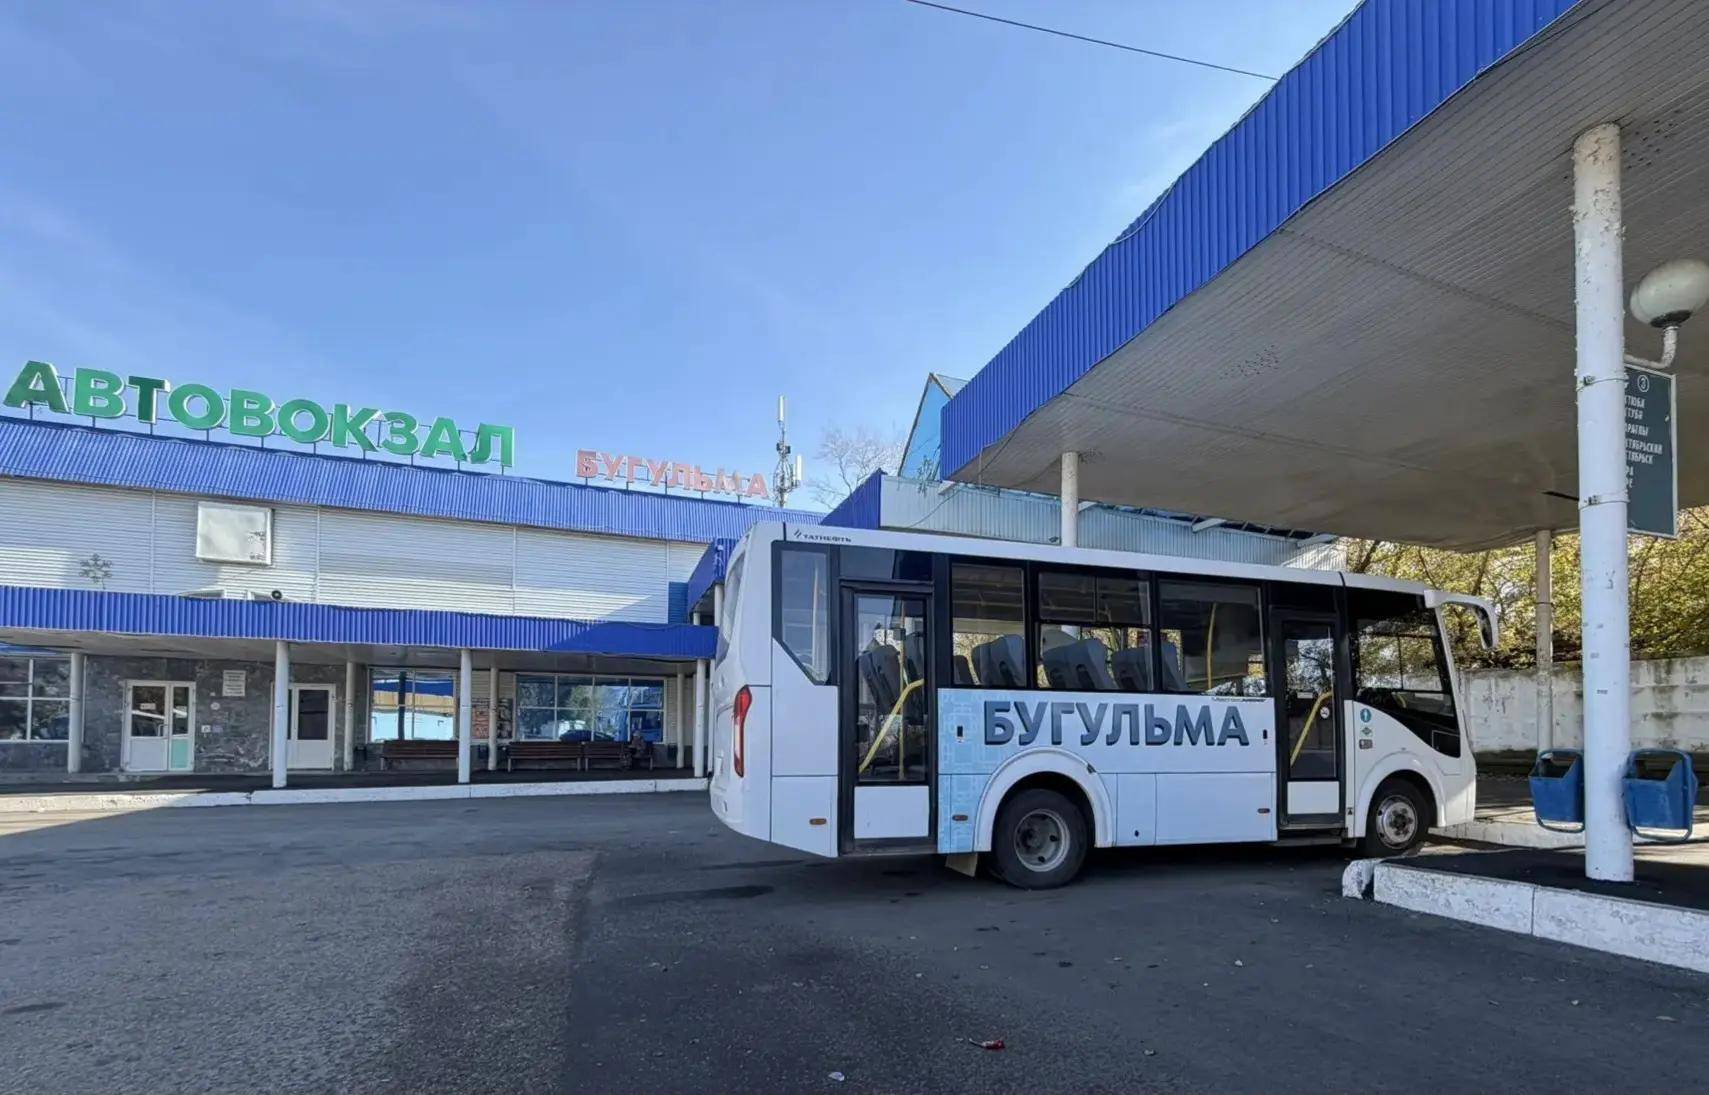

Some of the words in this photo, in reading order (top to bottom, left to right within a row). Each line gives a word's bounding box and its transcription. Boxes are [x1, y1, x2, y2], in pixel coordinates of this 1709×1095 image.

[3, 360, 516, 467] АВТОВОКЗАЛ
[576, 450, 769, 499] БУГУЛЬМА
[984, 700, 1250, 746] БУГУЛЬМА
